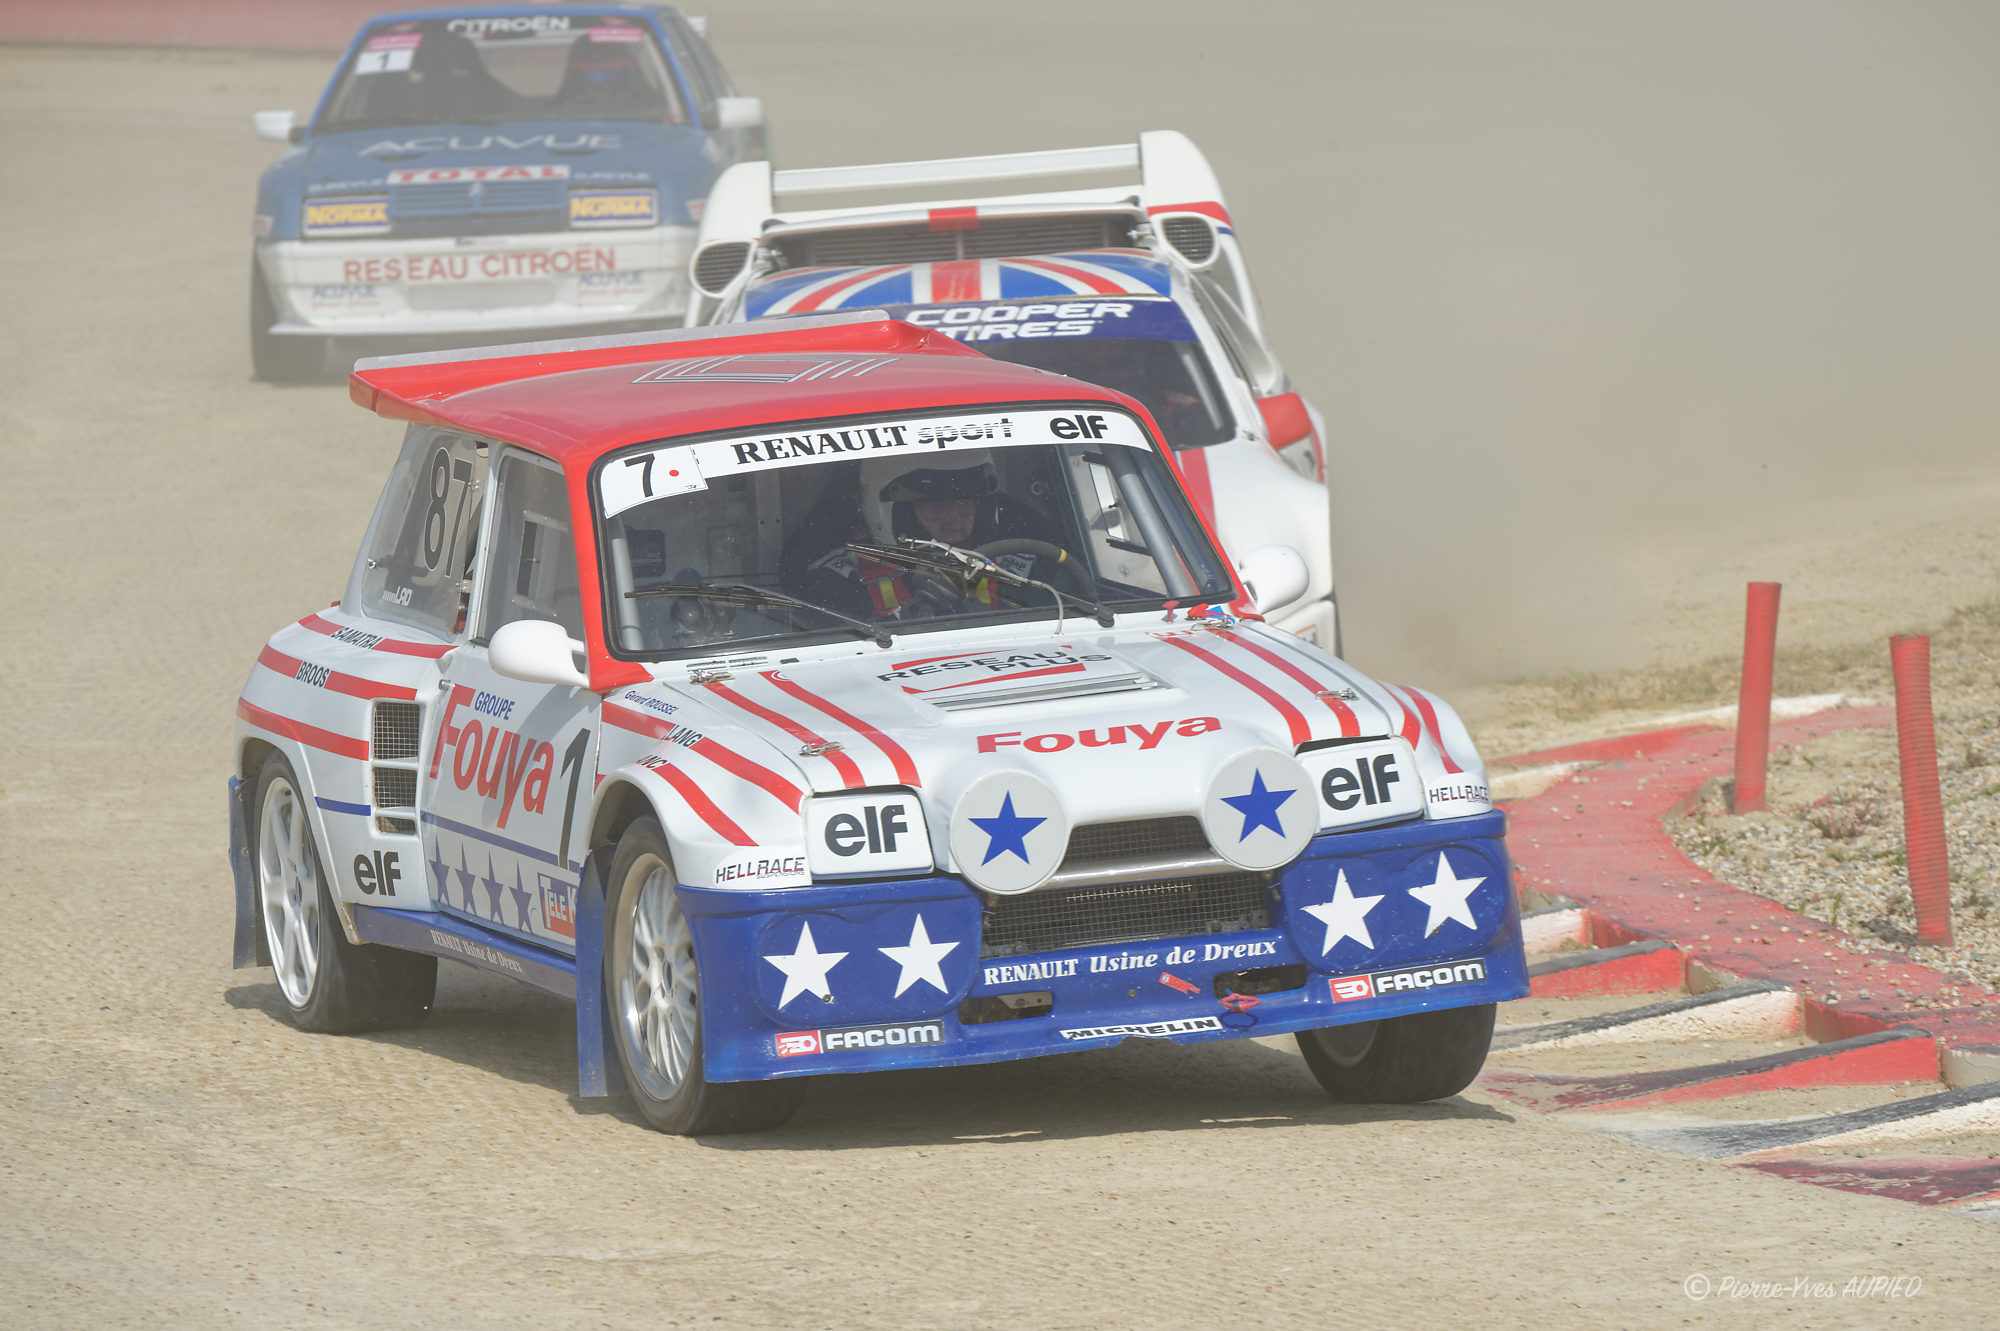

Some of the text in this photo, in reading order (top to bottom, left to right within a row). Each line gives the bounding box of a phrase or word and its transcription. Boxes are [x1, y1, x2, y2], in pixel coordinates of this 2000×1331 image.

[377, 53, 389, 71] 1
[357, 134, 624, 156] ACUVUE
[395, 165, 566, 182] TOTAL
[344, 243, 616, 283] RESEAU CITROËN
[905, 303, 1134, 326] COOPER
[937, 320, 1098, 342] TIRES
[730, 414, 1109, 465] RENAULT sport elf
[624, 453, 655, 497] 7
[424, 446, 474, 579] 87
[296, 661, 330, 688] BROOS
[877, 650, 1112, 682] RESEAU PLUS
[474, 691, 515, 720] GROUPE
[977, 716, 1222, 753] Fouya
[429, 683, 555, 829] Fouya
[1321, 753, 1400, 811] elf
[1429, 785, 1488, 803] HELLRACE
[560, 728, 591, 870] 1
[824, 805, 907, 857] elf
[353, 850, 401, 896] elf
[715, 857, 805, 884] HELLRACE
[431, 929, 523, 973] RENAULT Usine de Dreux
[984, 940, 1277, 986] RENAULT Usine de Dreux
[1376, 963, 1485, 993] FACOM
[825, 1025, 940, 1050] FACOM
[1067, 1019, 1216, 1039] MICHELIN
